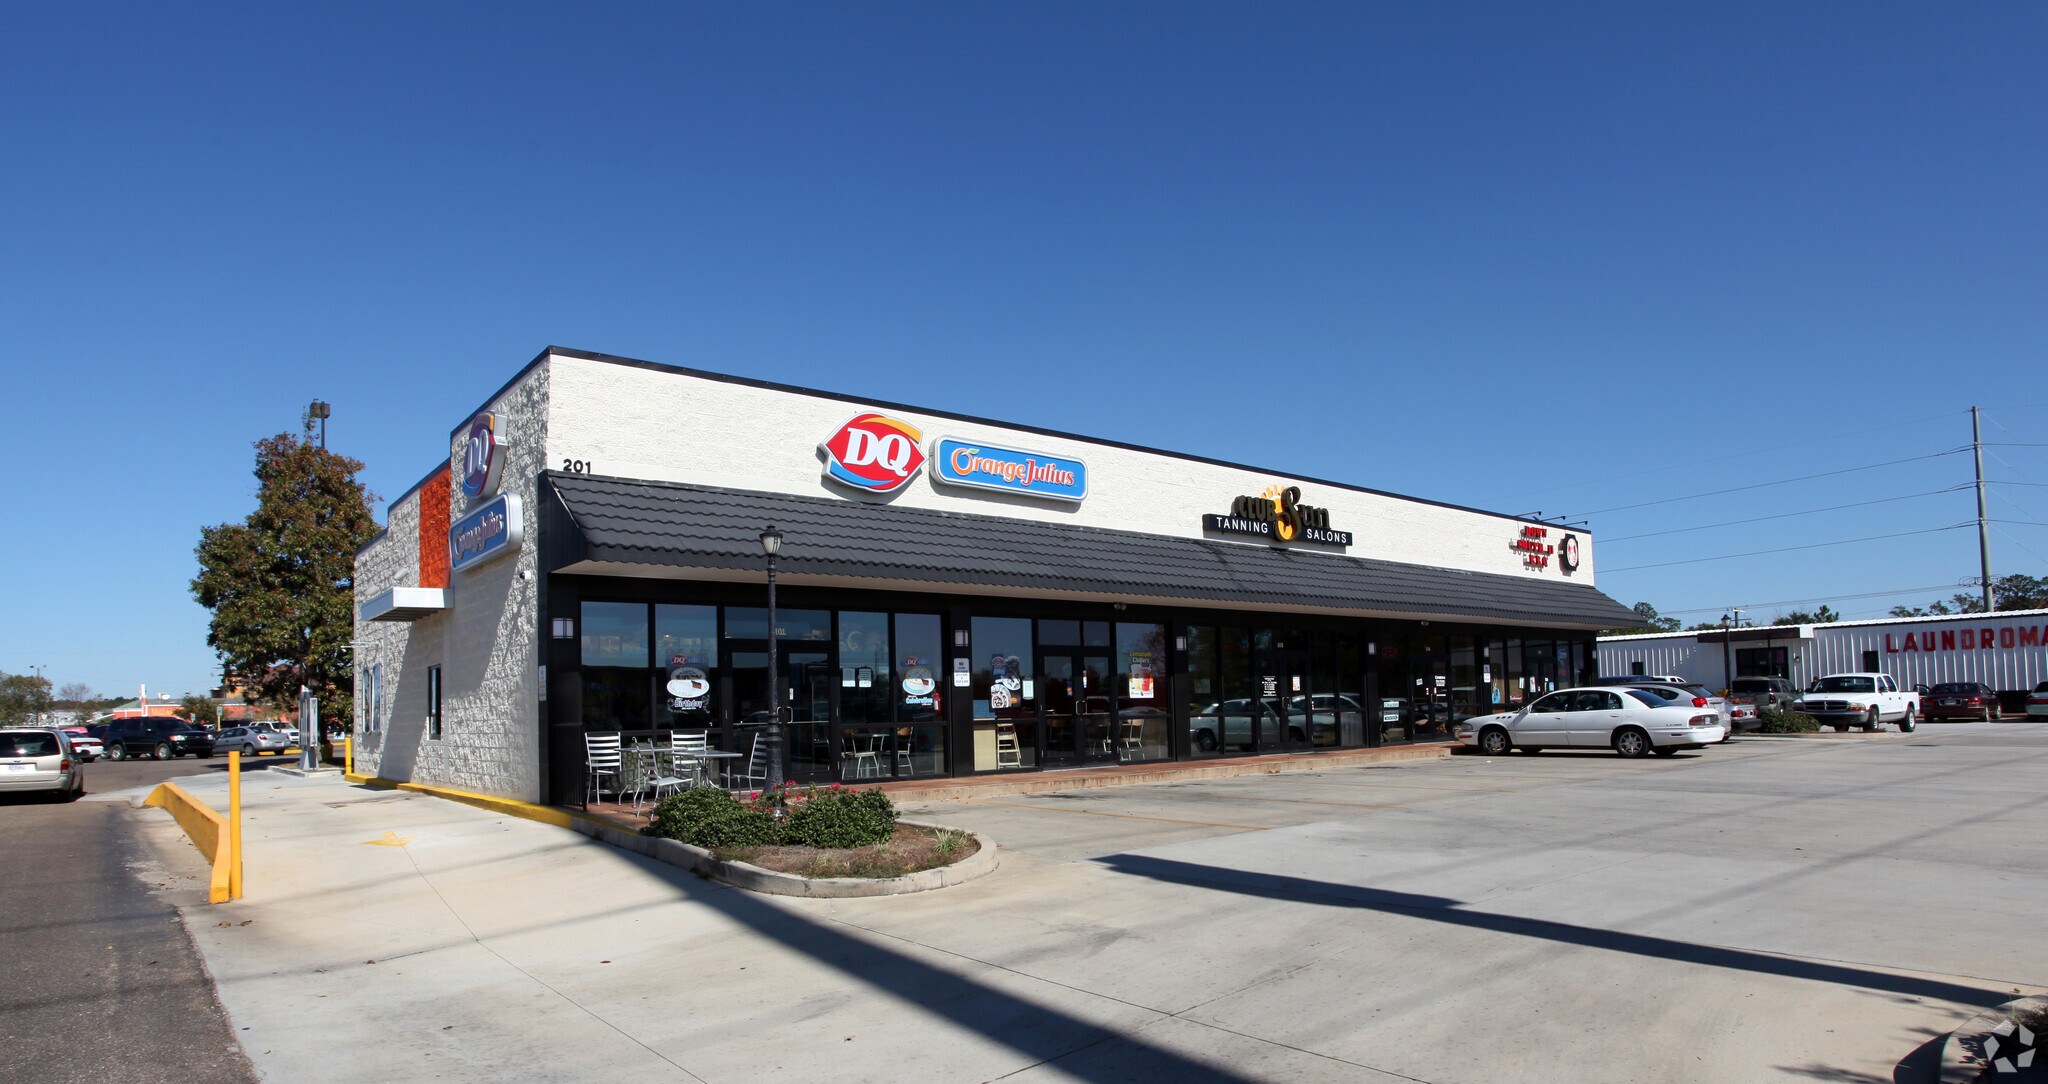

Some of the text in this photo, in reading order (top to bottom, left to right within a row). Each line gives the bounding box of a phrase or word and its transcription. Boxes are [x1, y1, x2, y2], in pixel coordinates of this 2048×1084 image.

[465, 429, 490, 479] DQ
[843, 427, 911, 477] DQ
[563, 458, 592, 475] 201
[951, 447, 1075, 486] Orange Julius
[1234, 486, 1331, 541] CLUB Sun
[1216, 516, 1268, 534] TANNING
[1524, 526, 1547, 538] DOWN
[1306, 528, 1347, 544] SALONS
[1529, 554, 1548, 567] BBQ
[673, 656, 686, 664] DQ
[675, 699, 703, 709] Birthday
